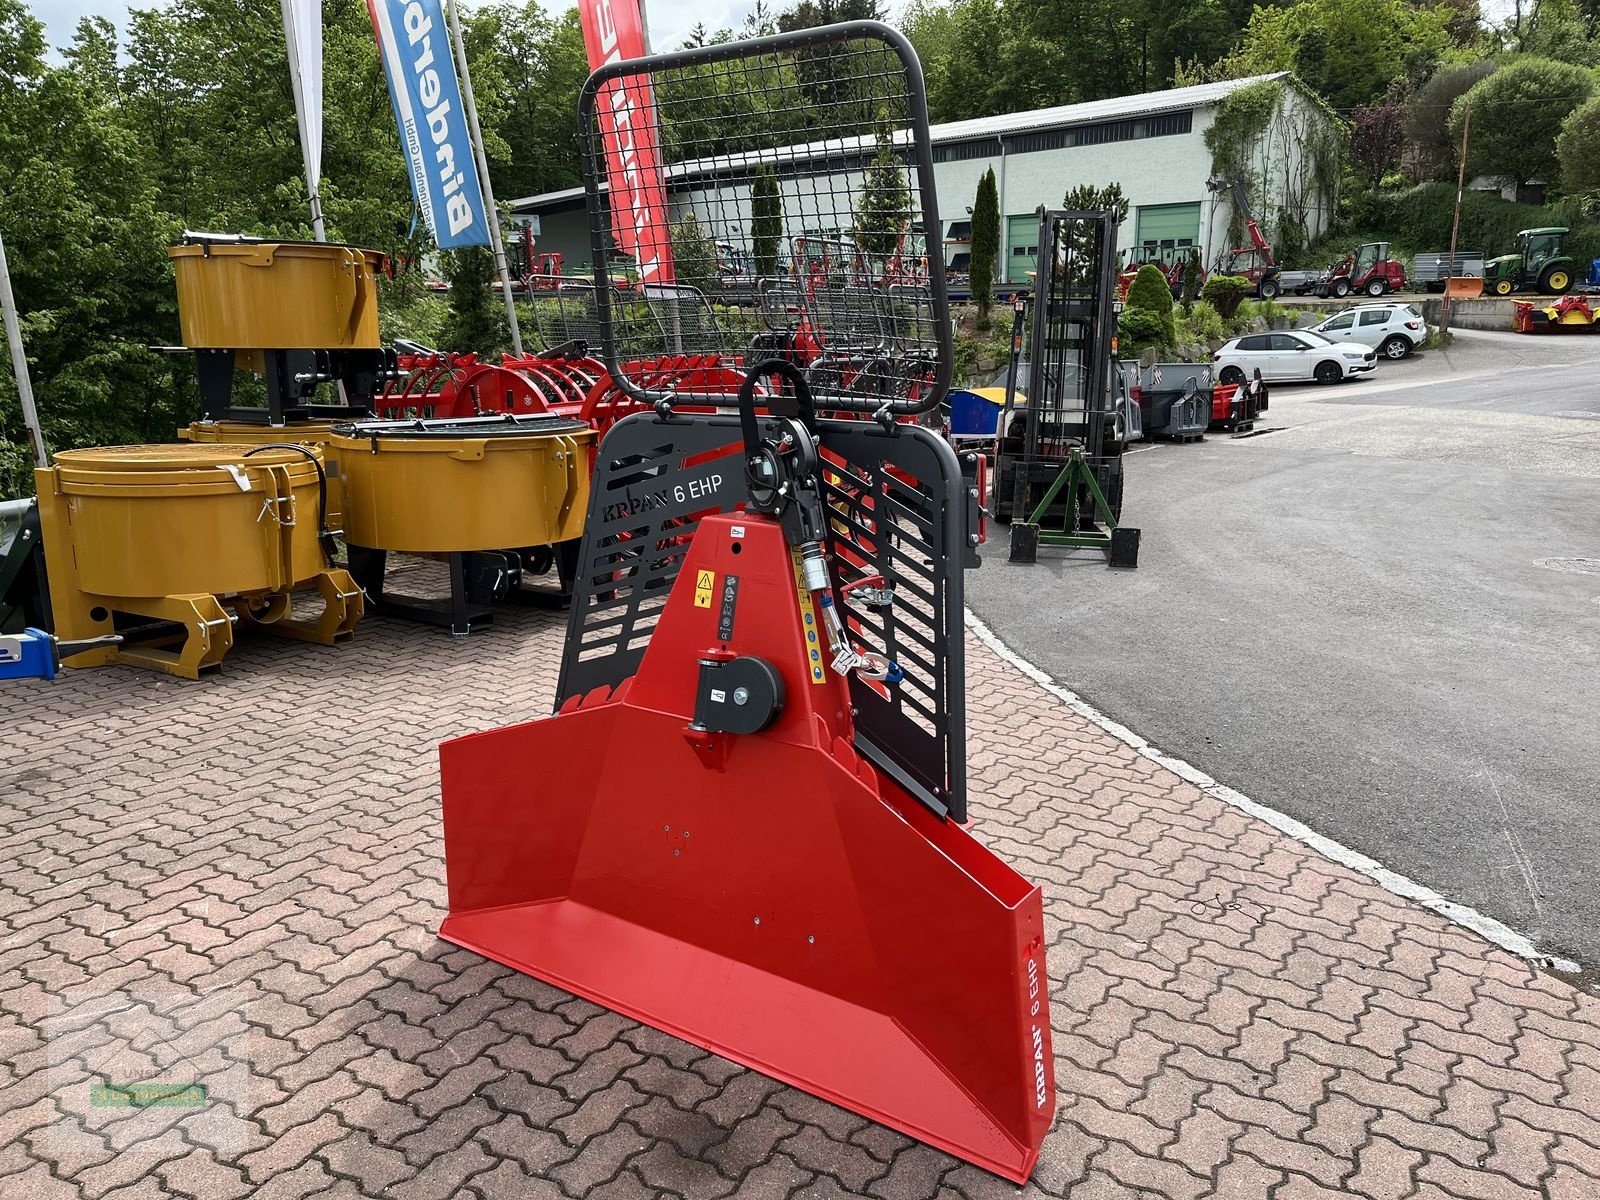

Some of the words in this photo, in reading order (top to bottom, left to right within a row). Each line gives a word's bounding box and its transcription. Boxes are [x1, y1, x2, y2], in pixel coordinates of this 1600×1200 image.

[601, 485, 668, 523] KRPAN
[673, 485, 686, 502] 6
[688, 474, 722, 499] EHP
[1028, 959, 1039, 999] EHP
[1031, 1000, 1040, 1016] 6
